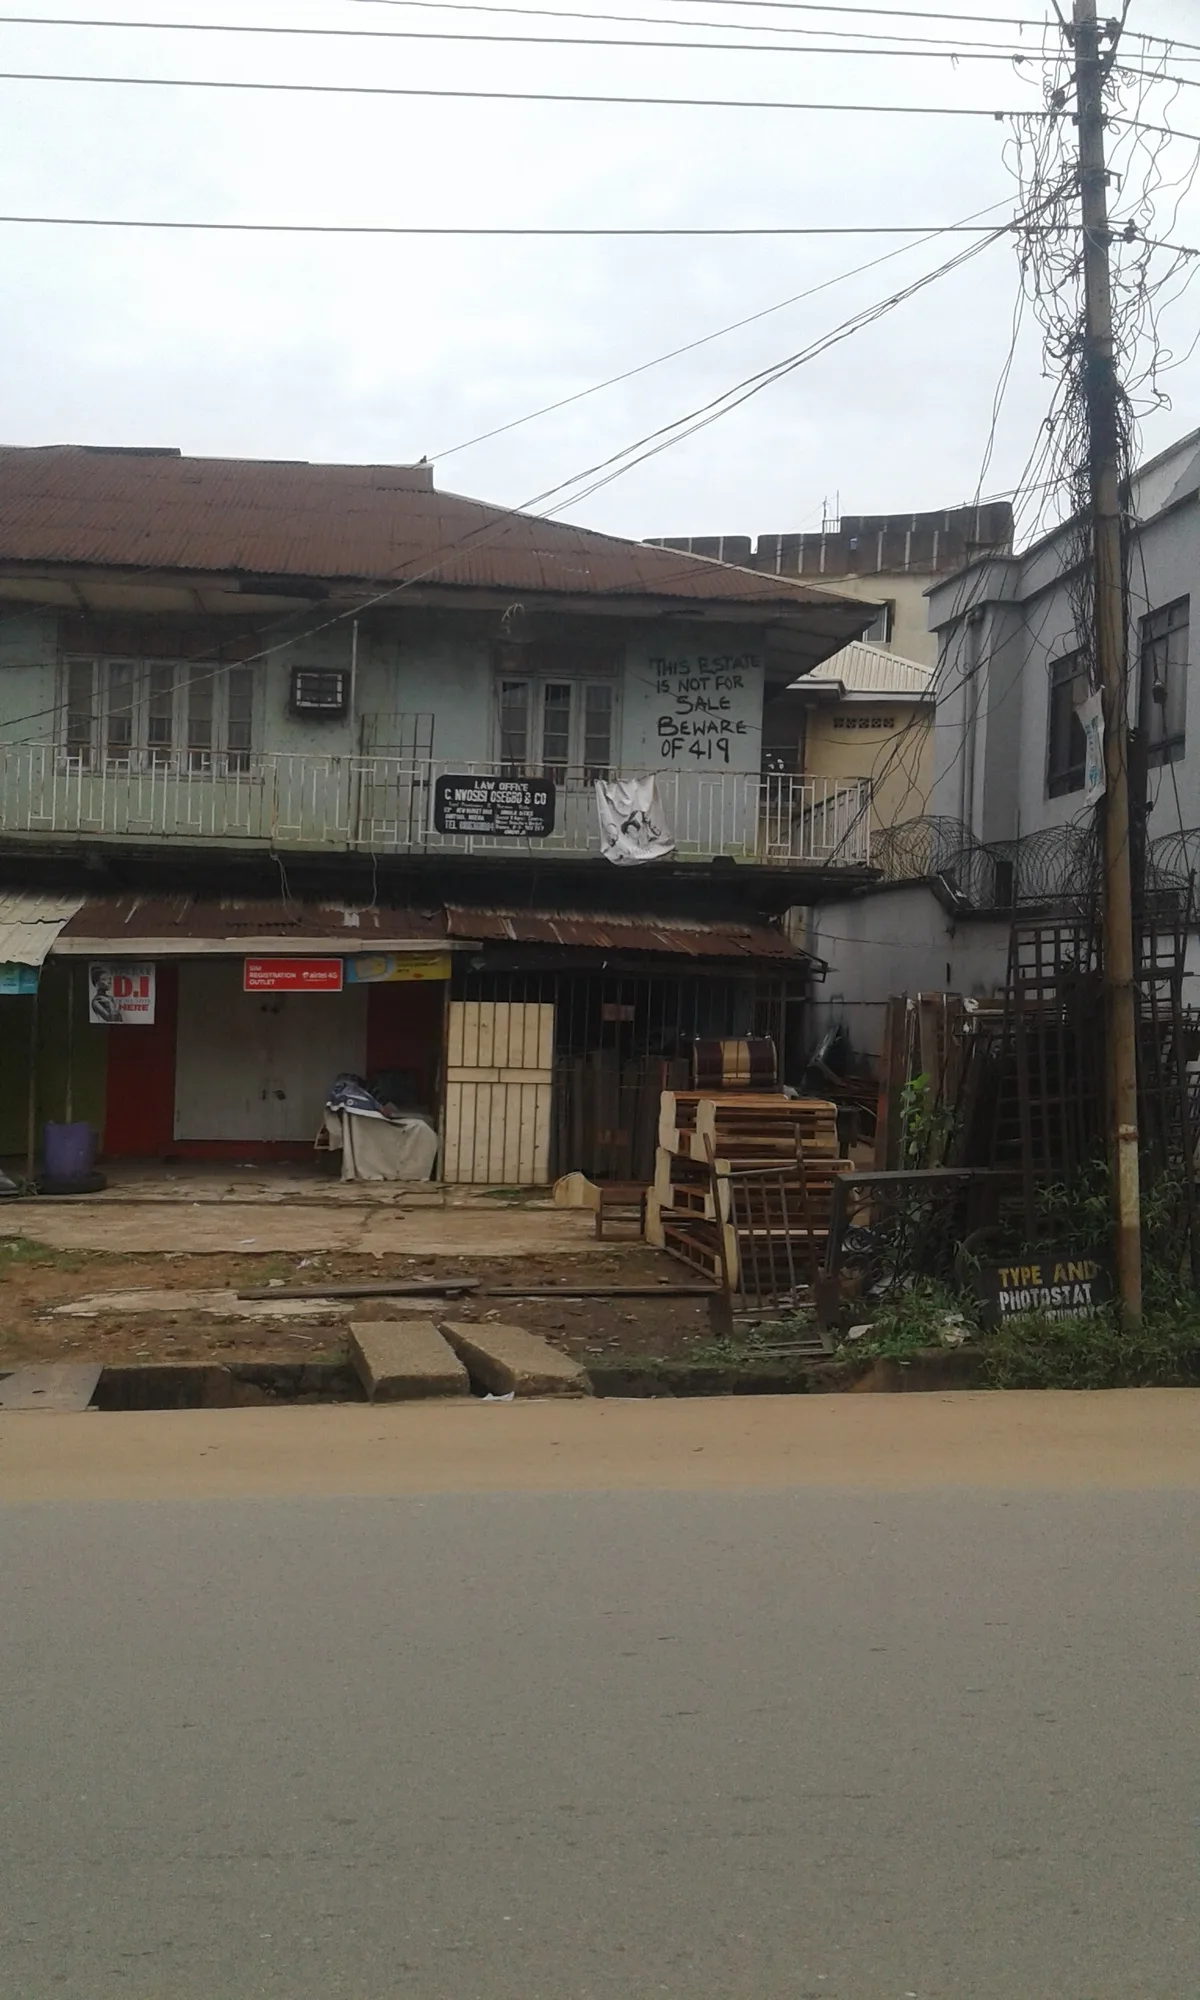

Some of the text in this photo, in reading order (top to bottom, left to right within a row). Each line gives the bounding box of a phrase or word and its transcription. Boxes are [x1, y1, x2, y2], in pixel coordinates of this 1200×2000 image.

[649, 655, 760, 676] THIS ESTATE
[657, 675, 744, 694] IS NOT FOR
[675, 696, 731, 715] SALE
[658, 716, 747, 736] BEWARE
[661, 738, 729, 763] OF 419
[475, 780, 529, 792] LAW OFFICE
[523, 792, 532, 805] &
[534, 792, 547, 806] CO
[998, 1260, 1099, 1288] TYPE AND
[999, 1283, 1092, 1311] PHOTOSTAT
